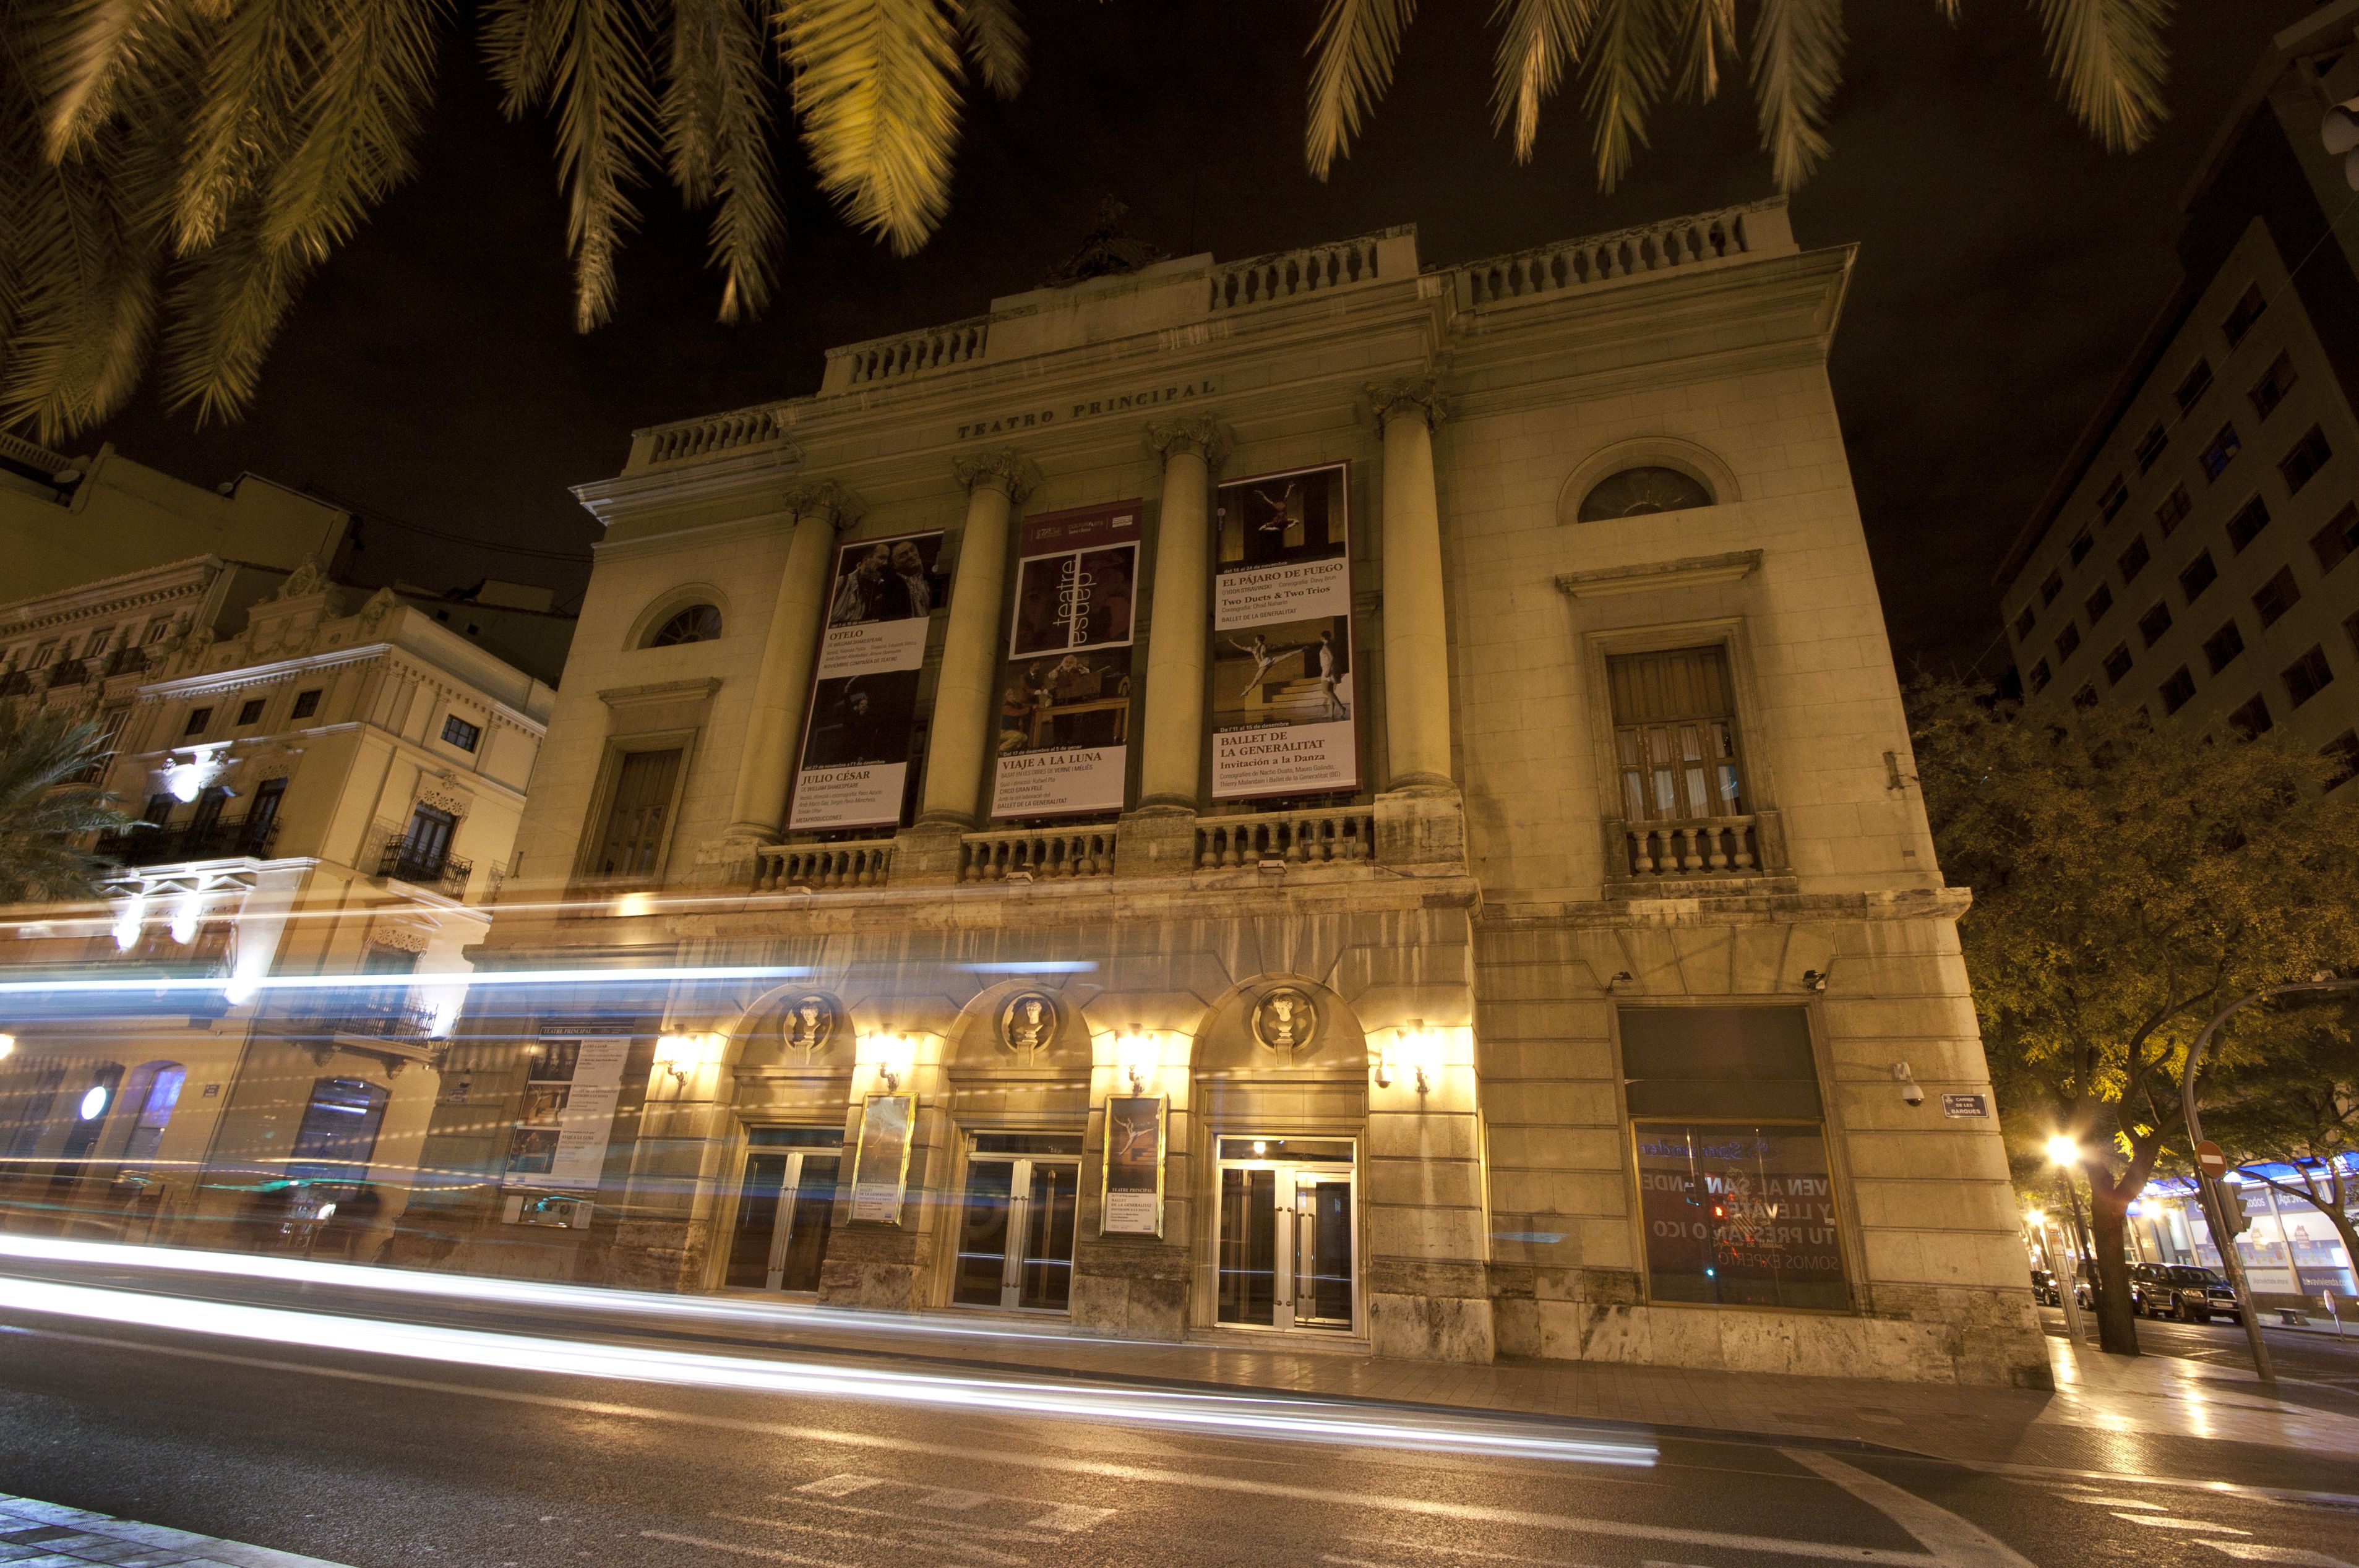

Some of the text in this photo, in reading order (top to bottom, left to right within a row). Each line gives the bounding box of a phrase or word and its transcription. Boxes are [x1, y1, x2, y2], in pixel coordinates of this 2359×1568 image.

[958, 380, 1216, 439] TEATRO PRINCIPAL
[1222, 563, 1343, 587] EL PÁJARO DE FUEGO
[1053, 560, 1075, 627] teatre
[1245, 594, 1271, 602] Duets
[1306, 586, 1330, 594] Trios
[1073, 573, 1097, 644] dansa
[1260, 609, 1297, 617] GENERALITAT
[830, 629, 864, 640] OTELO
[1221, 732, 1287, 745] BALLET DE
[1221, 739, 1325, 757] LA GENERALITAT
[1002, 753, 1102, 770] VIAJE A LA LUNA
[1221, 758, 1269, 769] Invitación
[1294, 753, 1325, 762] Danza
[801, 769, 870, 786] JULIO CÉSAR
